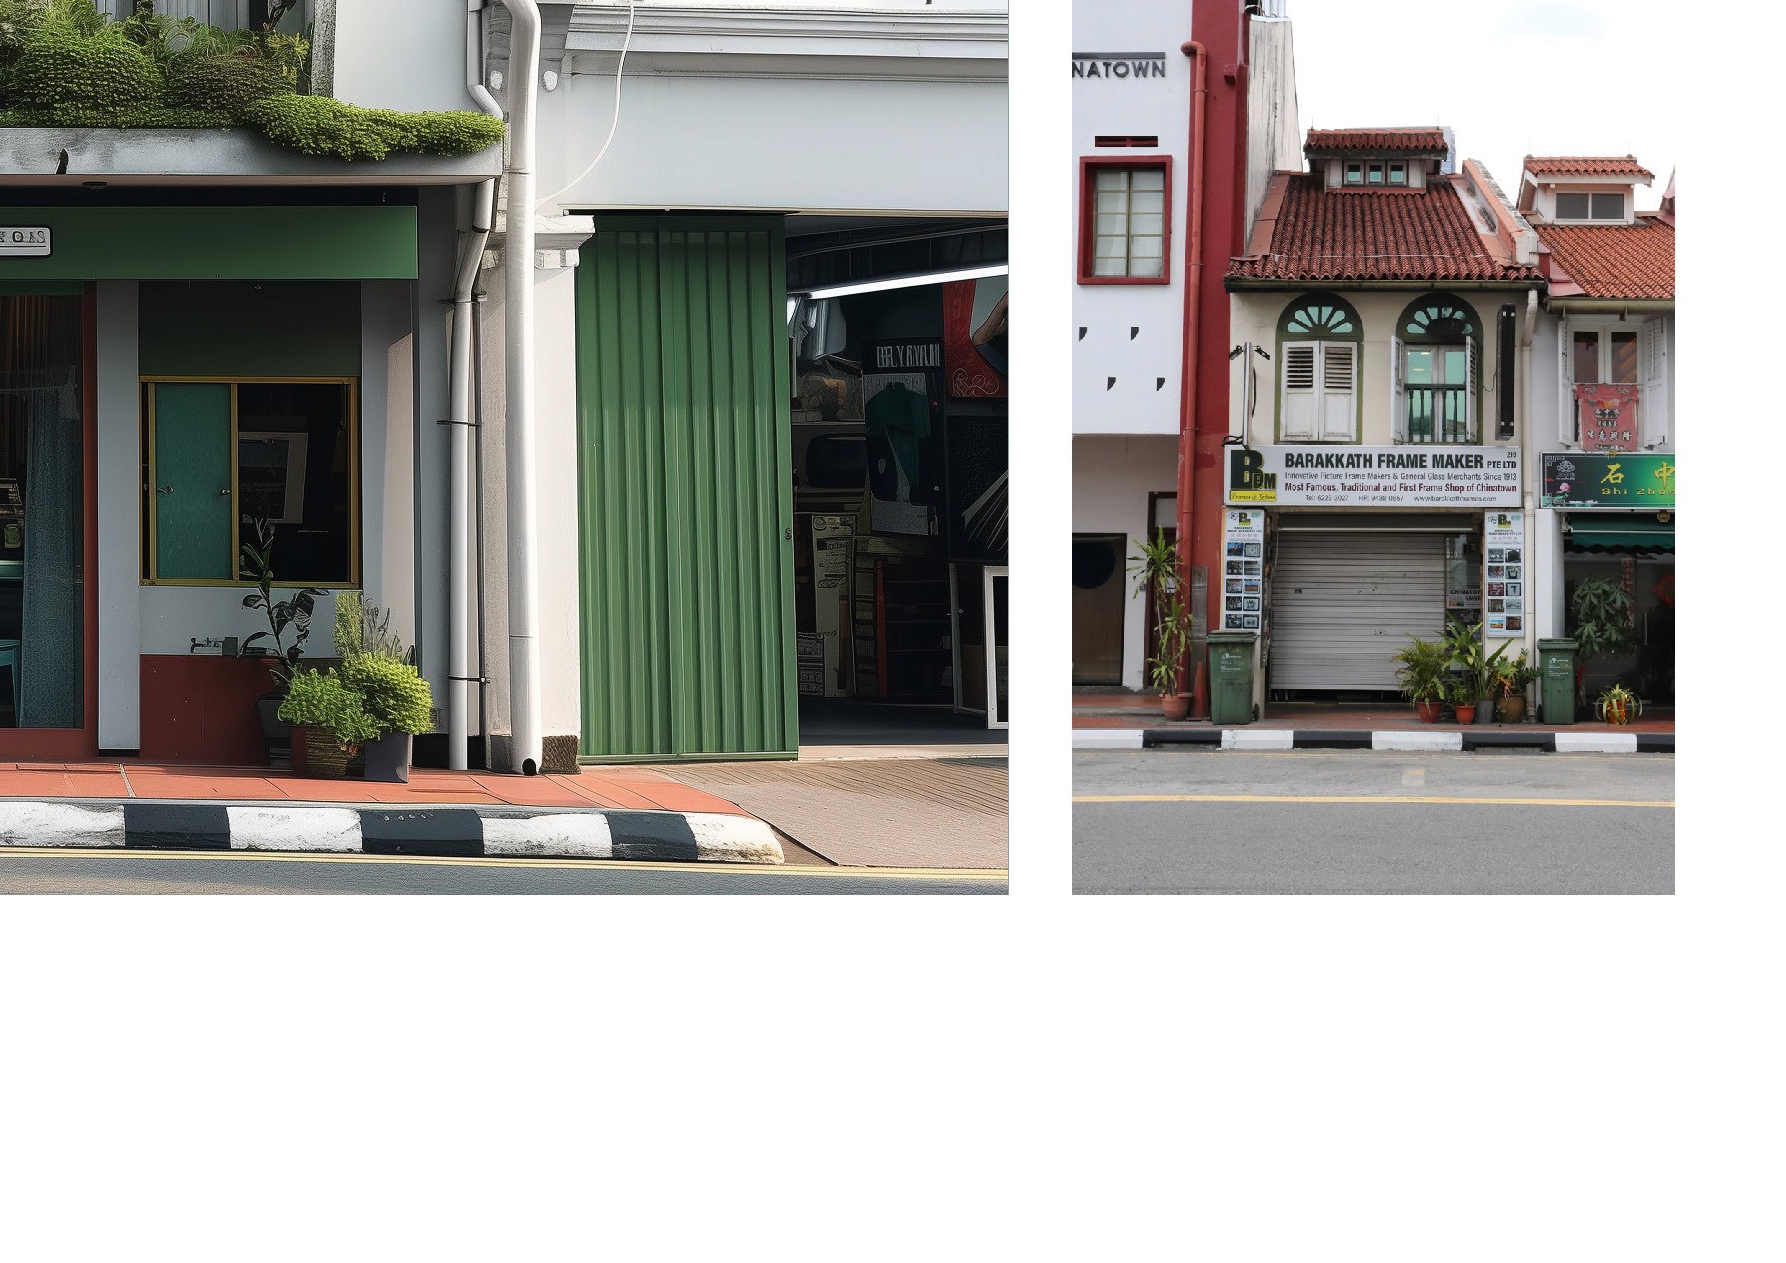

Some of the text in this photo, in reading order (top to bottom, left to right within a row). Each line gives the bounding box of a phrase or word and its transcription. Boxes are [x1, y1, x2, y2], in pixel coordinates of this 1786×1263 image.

[1072, 60, 1166, 78] NATOWN
[1284, 452, 1517, 469] BARAKKATH FRAME MAKER PTE LTD
[1284, 471, 1319, 480] Innovative
[1320, 471, 1343, 480] Picture
[1344, 472, 1366, 480] Frame
[1367, 472, 1391, 480] Makers
[1392, 472, 1399, 480] &
[1400, 472, 1426, 481] General
[1427, 472, 1446, 481] Glass
[1447, 472, 1482, 481] Merchants
[1483, 472, 1502, 481] Since
[1284, 482, 1517, 494] Most Famous, Traditional and First Frame Shop of Chinatown
